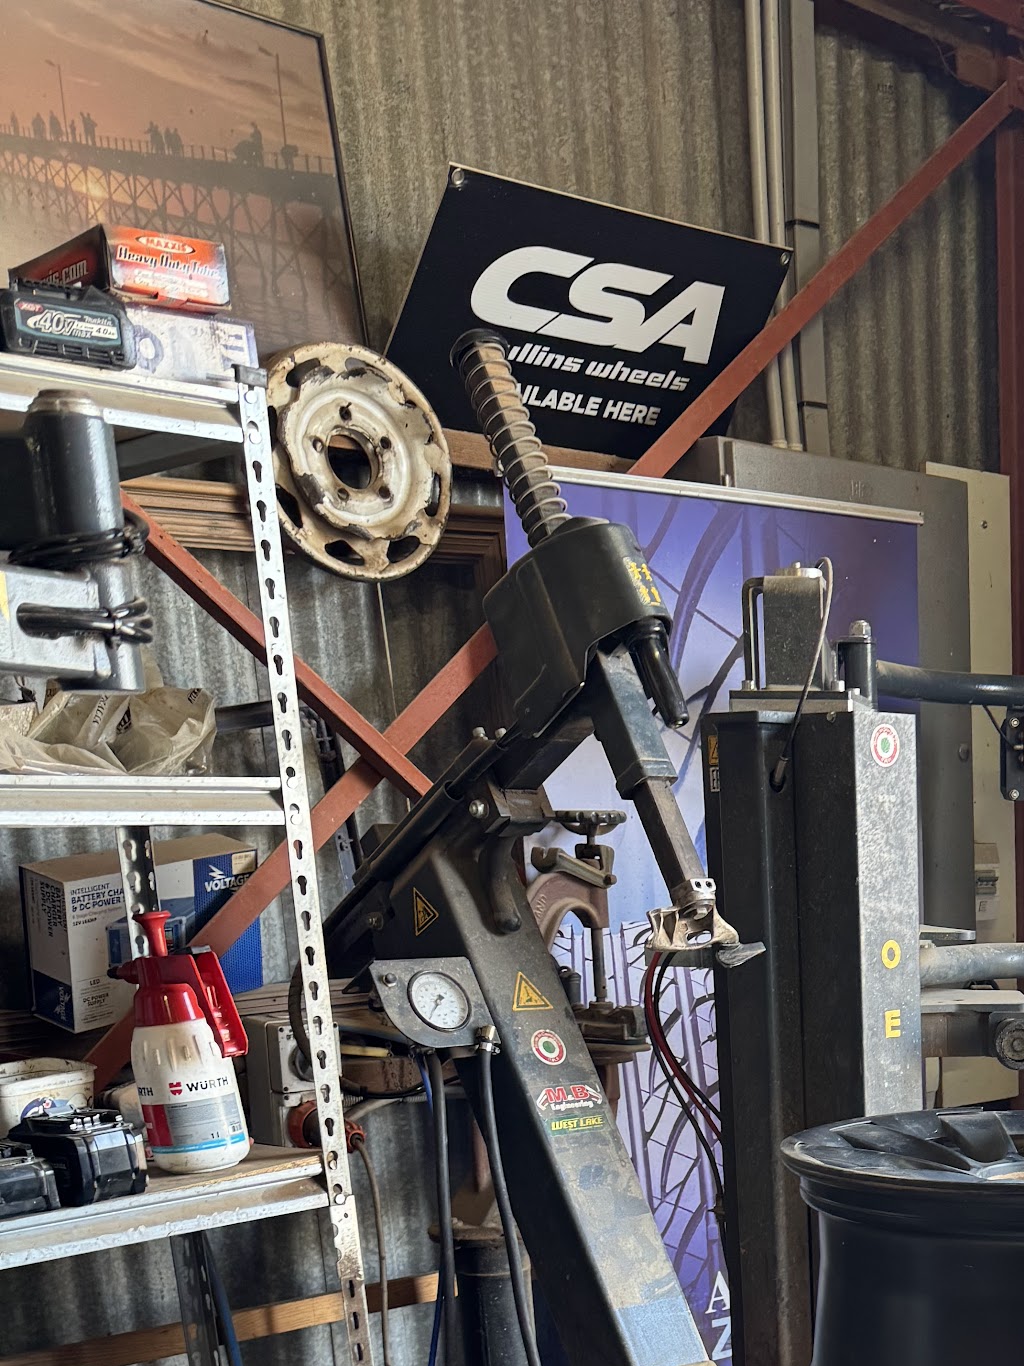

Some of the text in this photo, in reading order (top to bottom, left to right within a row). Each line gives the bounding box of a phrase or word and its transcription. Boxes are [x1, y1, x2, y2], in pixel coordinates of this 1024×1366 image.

[117, 246, 157, 268] Heavy
[160, 254, 190, 276] Duty
[471, 246, 726, 365] CSA
[585, 360, 691, 393] wheels
[517, 383, 662, 427] ILABLE HERE
[70, 882, 111, 896] INTELLIGENT
[71, 891, 107, 905] BATTERY
[72, 896, 122, 913] & DC POWER
[881, 939, 902, 969] O
[885, 1009, 902, 1039] E
[138, 1086, 154, 1097] RTH
[186, 1076, 230, 1093] WÜRTH
[550, 1099, 594, 1112] Engineering
[551, 1115, 604, 1131] WEST LAKE
